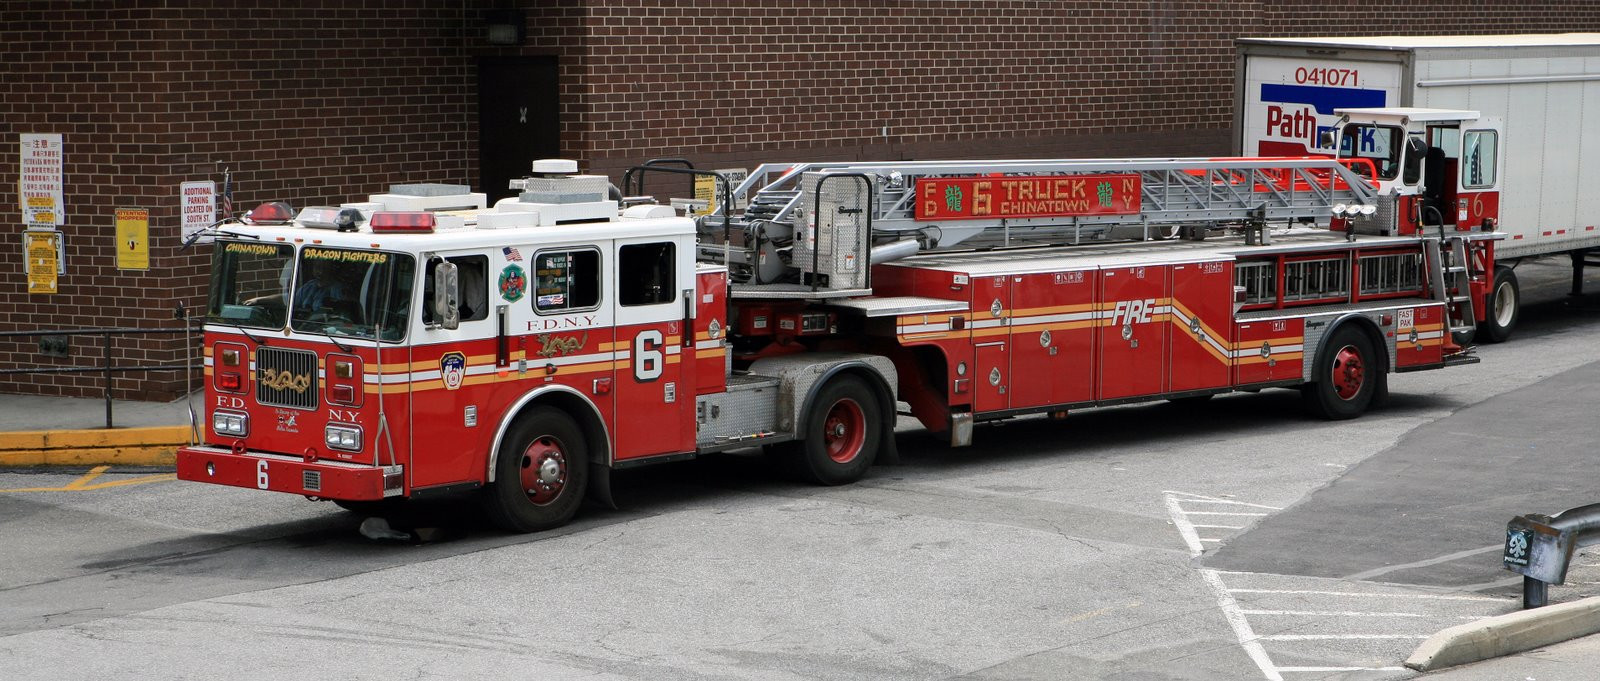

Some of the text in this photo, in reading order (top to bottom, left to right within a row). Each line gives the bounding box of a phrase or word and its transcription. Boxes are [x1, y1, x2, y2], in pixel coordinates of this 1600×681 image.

[1295, 66, 1358, 87] 041071
[184, 187, 212, 195] ADDITIONAL
[1002, 178, 1087, 200] TRUCK
[188, 196, 208, 204] PARKING
[972, 181, 992, 216] 6
[1473, 192, 1484, 218] 6
[184, 205, 212, 213] LOCATED ON
[1001, 199, 1090, 215] CHINATOWN
[187, 215, 202, 223] SOUTH
[225, 243, 277, 255] CHINATOWN
[304, 248, 387, 264] DRAGON FIGHTERS
[1112, 298, 1156, 326] FIRE
[1399, 310, 1413, 318] FAST
[526, 315, 599, 331] F.D.N.Y.
[1400, 319, 1412, 327] PAK
[634, 329, 663, 383] 6
[216, 395, 248, 410] F.D.
[329, 408, 363, 424] N.Y.
[257, 459, 269, 490] 6
